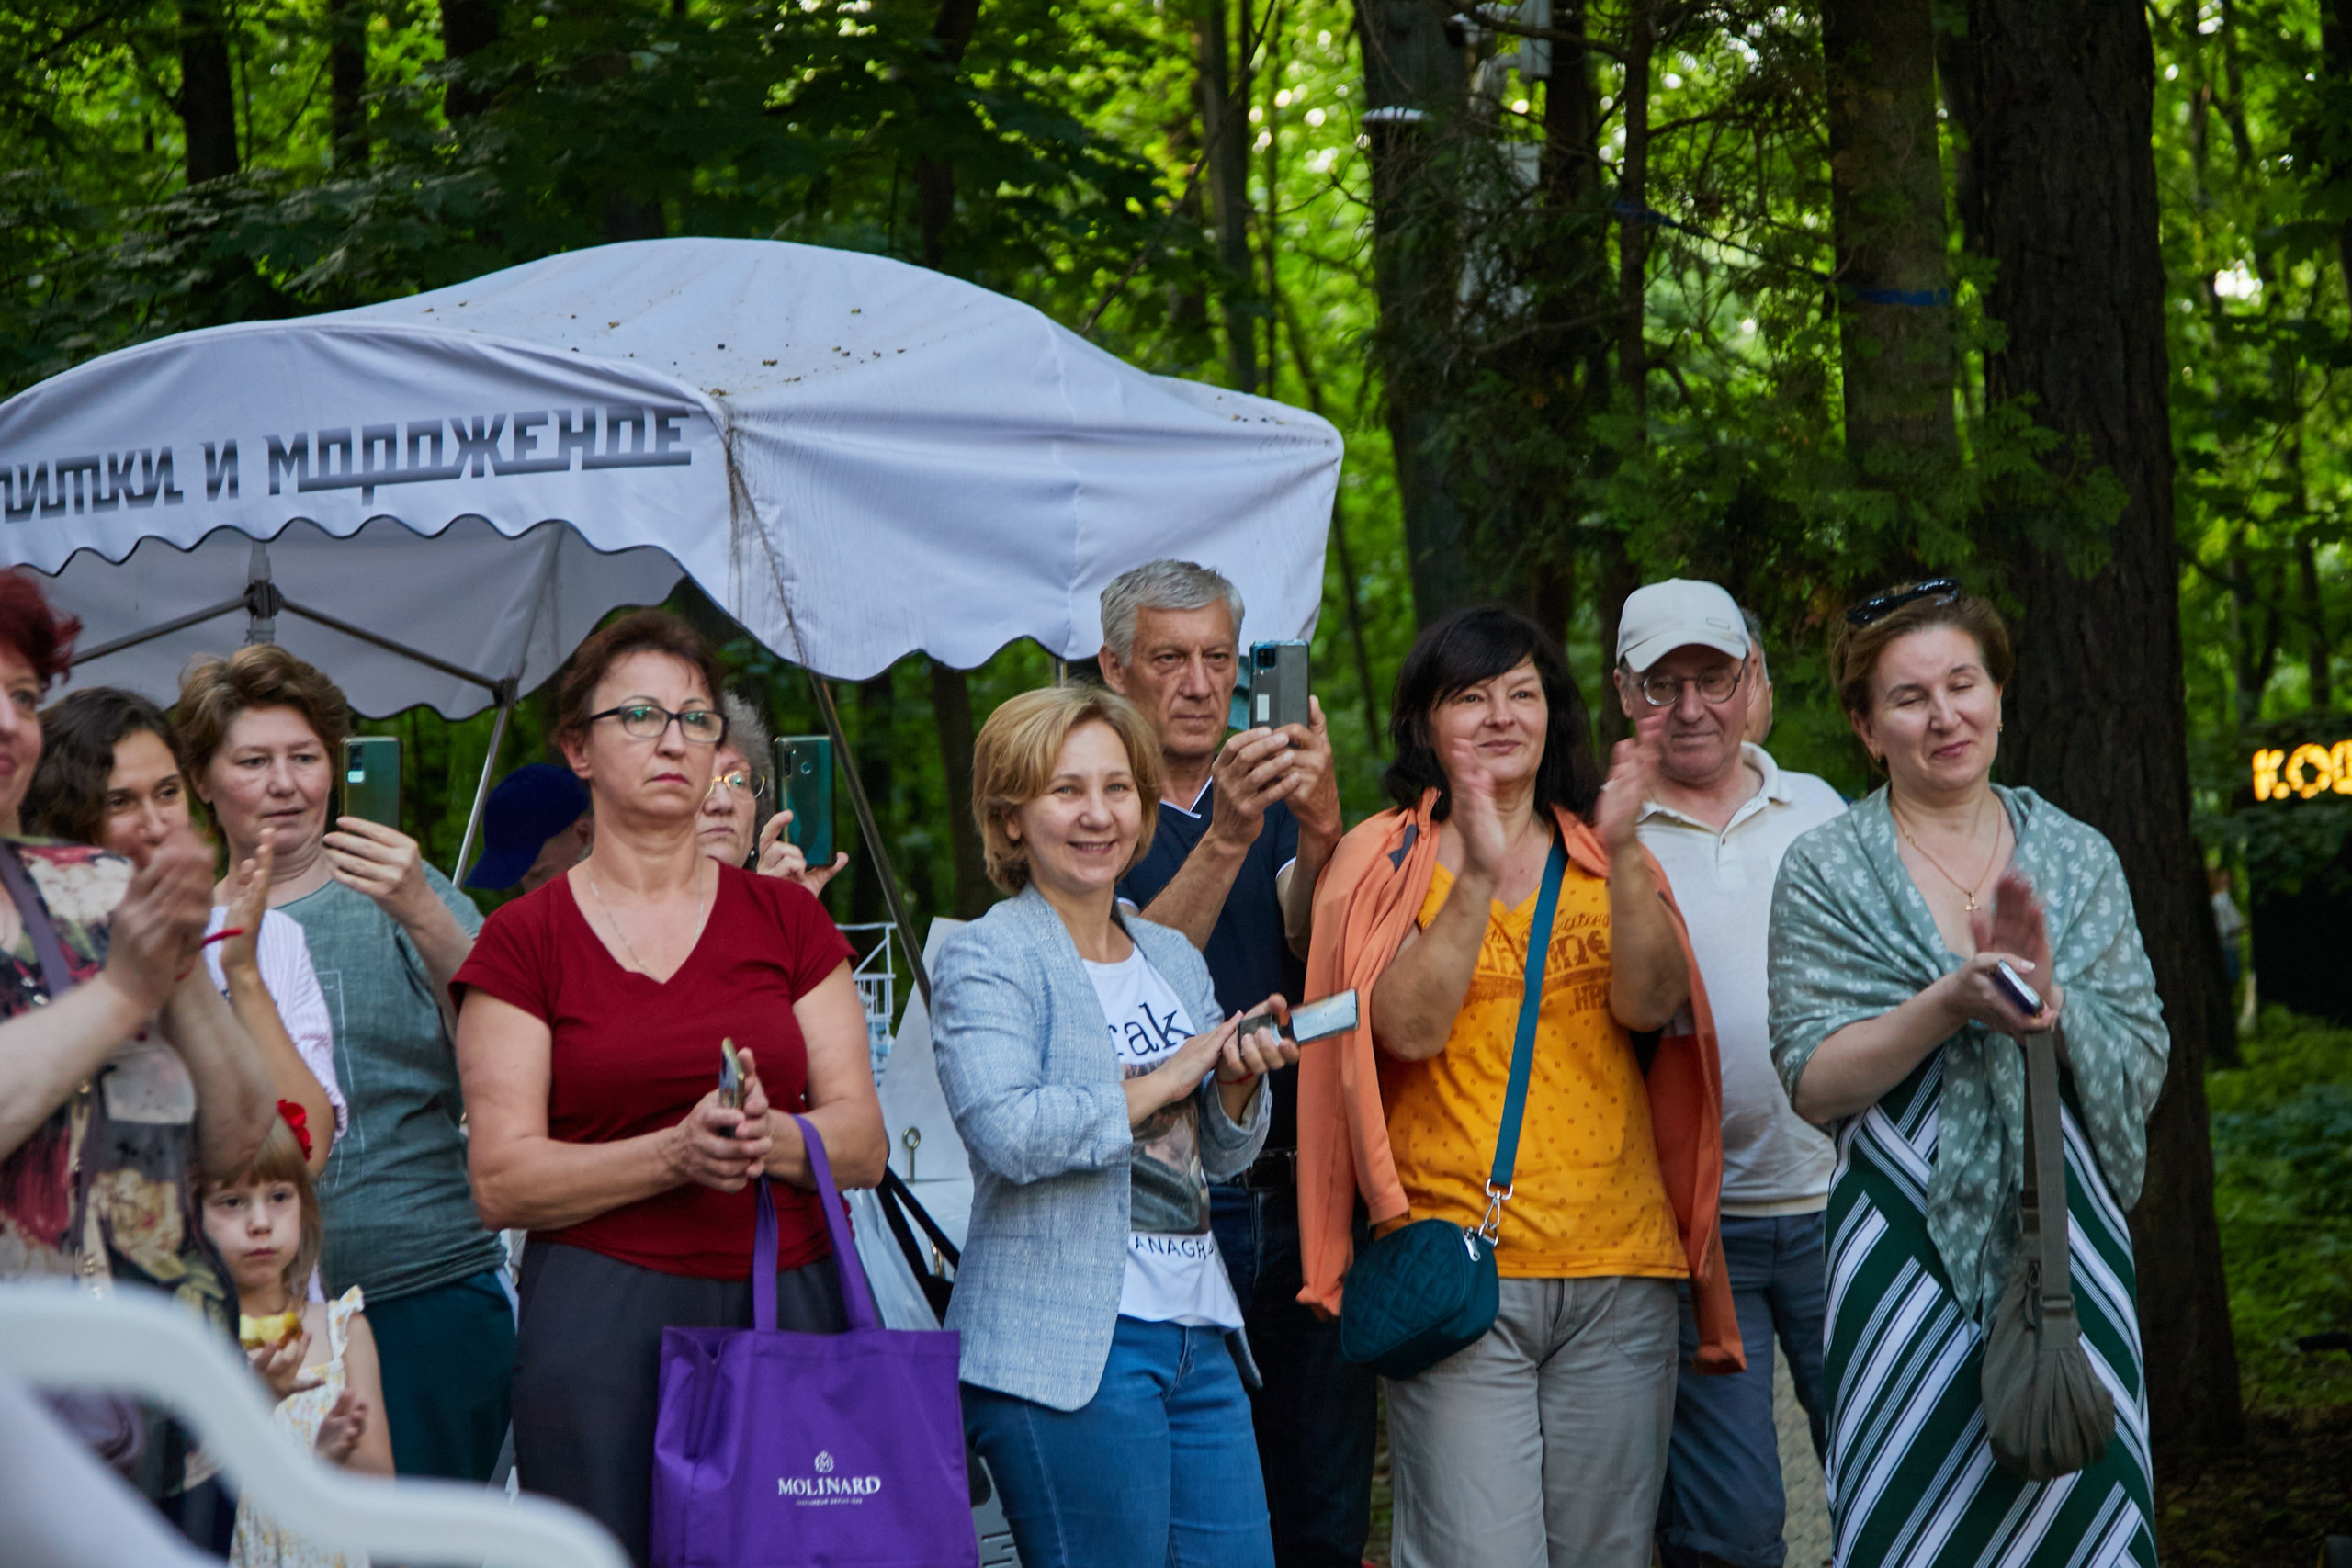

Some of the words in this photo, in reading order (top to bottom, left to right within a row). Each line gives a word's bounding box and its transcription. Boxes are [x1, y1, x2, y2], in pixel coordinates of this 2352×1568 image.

[199, 438, 240, 502] И
[263, 407, 693, 506] МОРОЖЕНОЕ
[1108, 1001, 1196, 1056] ak
[777, 1475, 881, 1497] MOLINARD
